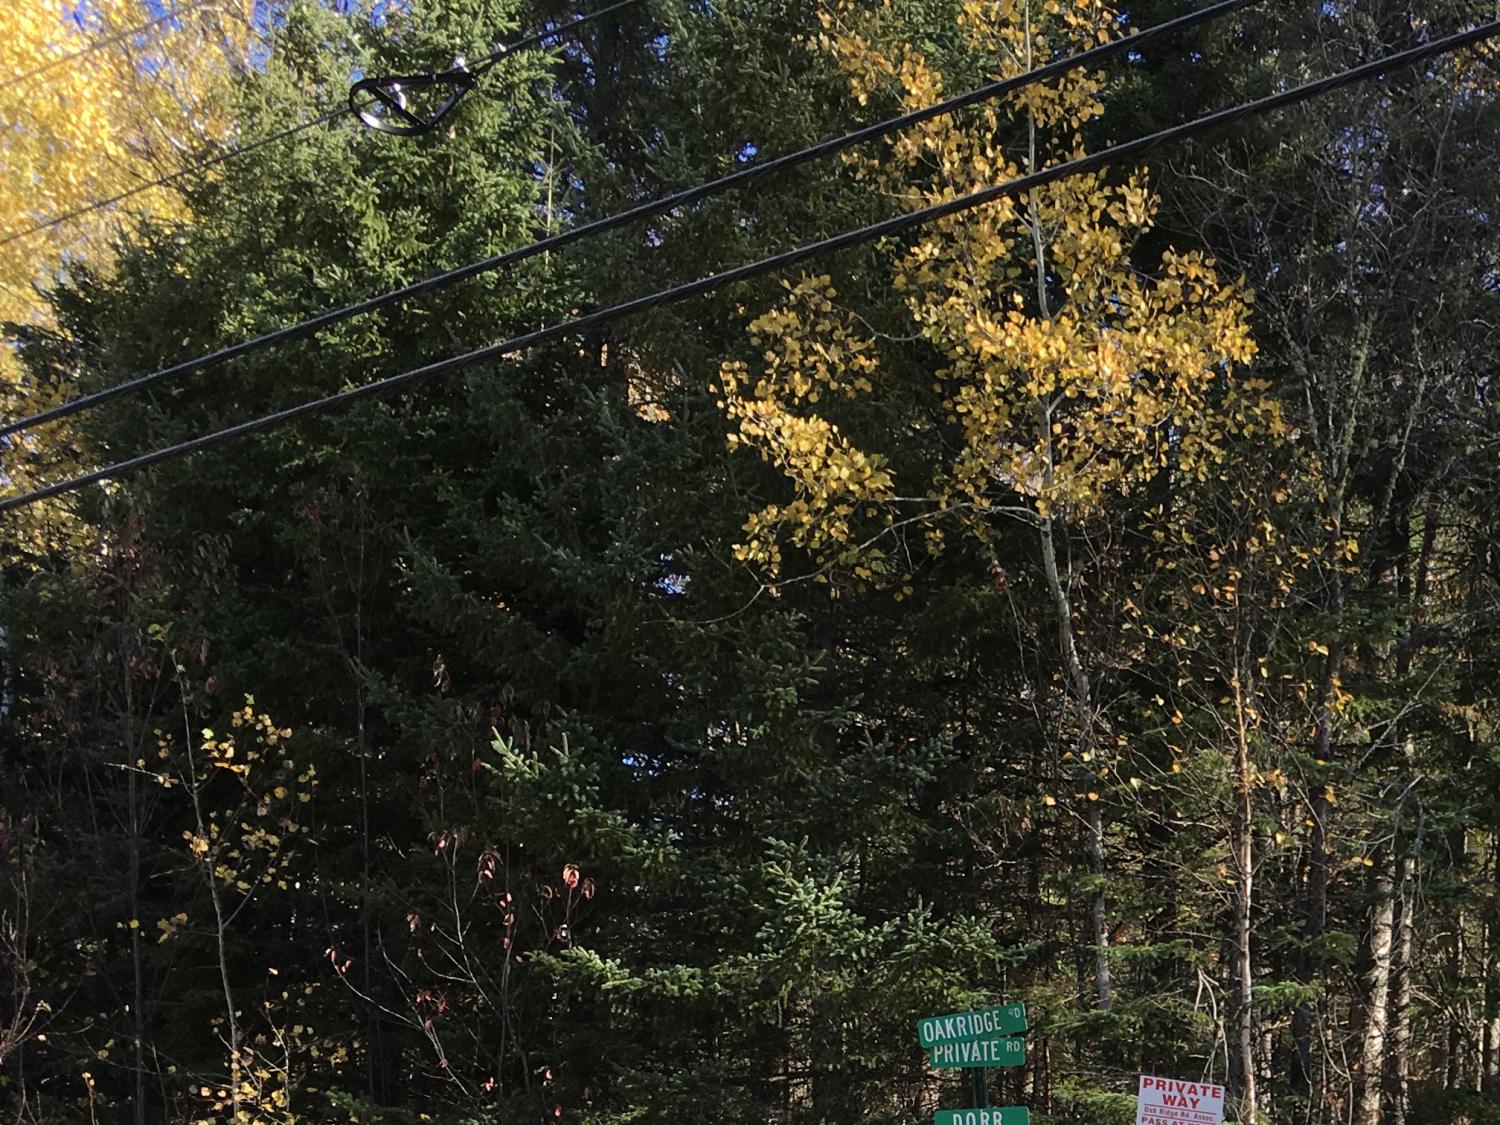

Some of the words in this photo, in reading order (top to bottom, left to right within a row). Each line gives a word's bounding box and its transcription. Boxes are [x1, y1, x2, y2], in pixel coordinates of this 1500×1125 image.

[923, 1010, 1002, 1042] OAKRIDGE
[933, 1040, 1000, 1063] PRIVATE
[1006, 1041, 1021, 1052] RD
[1142, 1077, 1222, 1099] PRIVATE
[1144, 1106, 1157, 1114] Oak
[1160, 1107, 1179, 1118] Ridge
[1162, 1094, 1201, 1109] WAY
